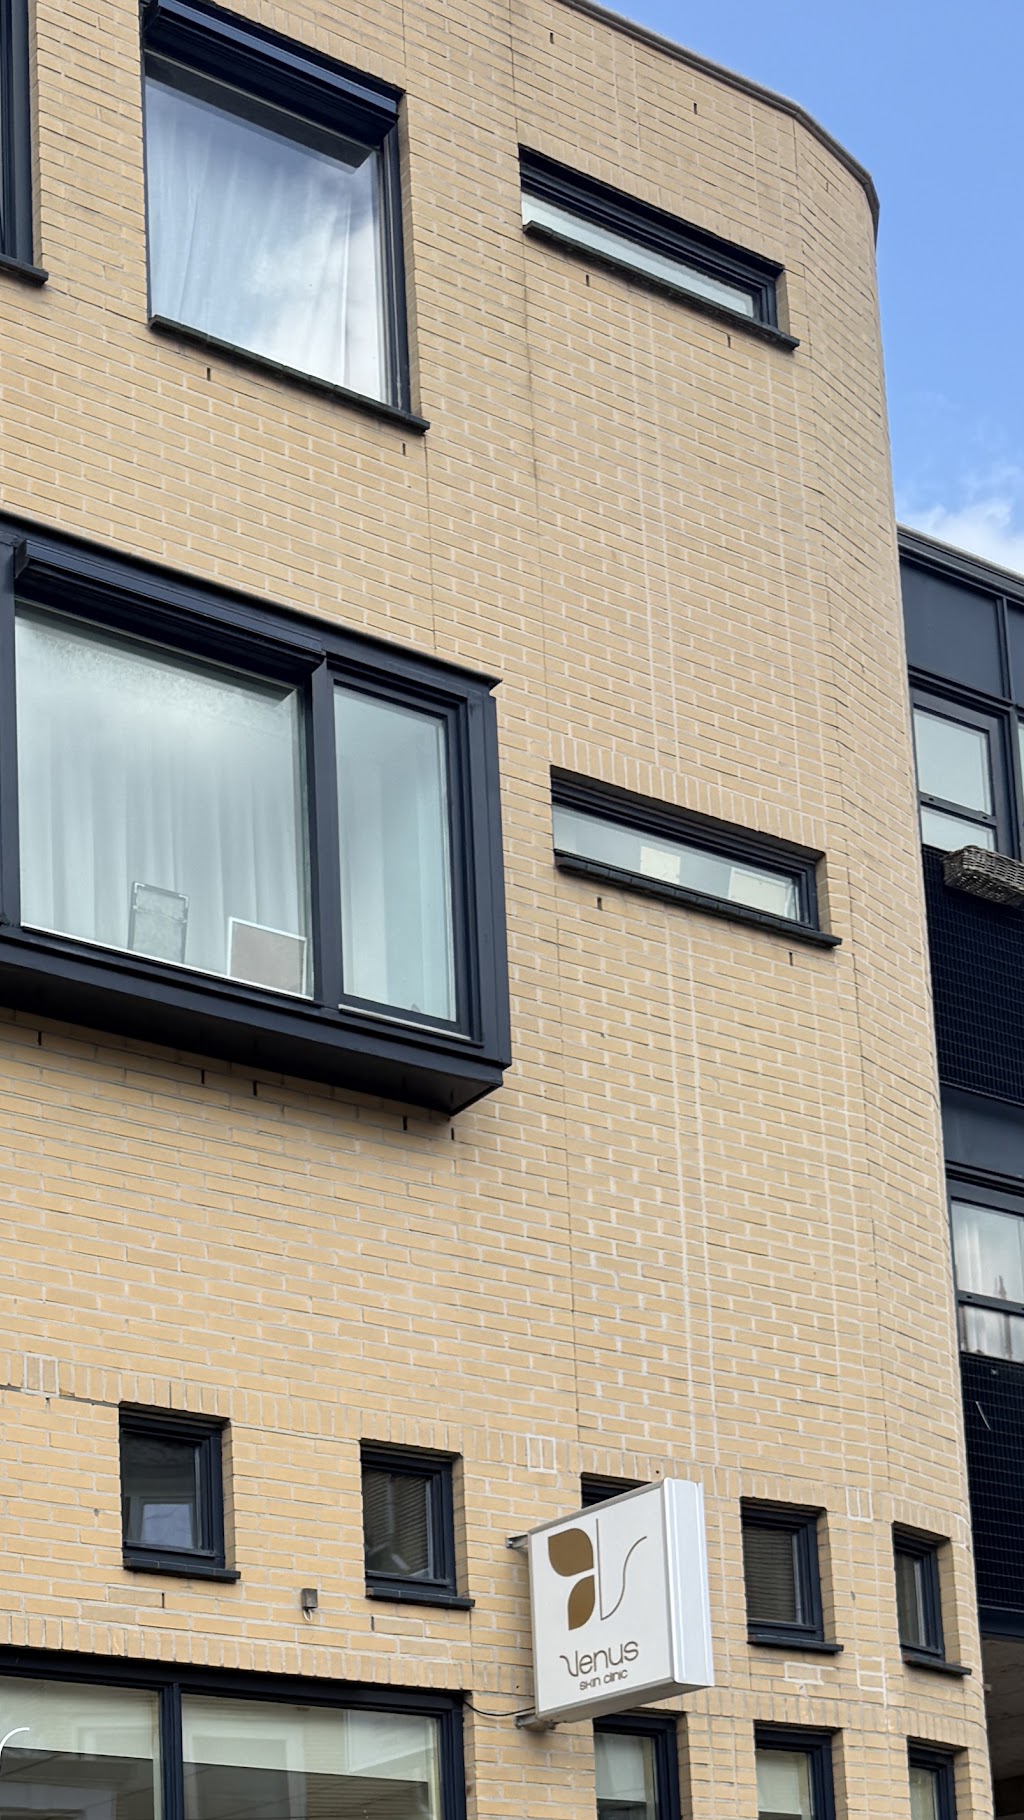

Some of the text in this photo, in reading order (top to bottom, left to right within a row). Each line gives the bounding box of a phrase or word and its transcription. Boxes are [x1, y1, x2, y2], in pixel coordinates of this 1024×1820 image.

[559, 1640, 639, 1678] Venus
[579, 1669, 629, 1691] skin clinic
